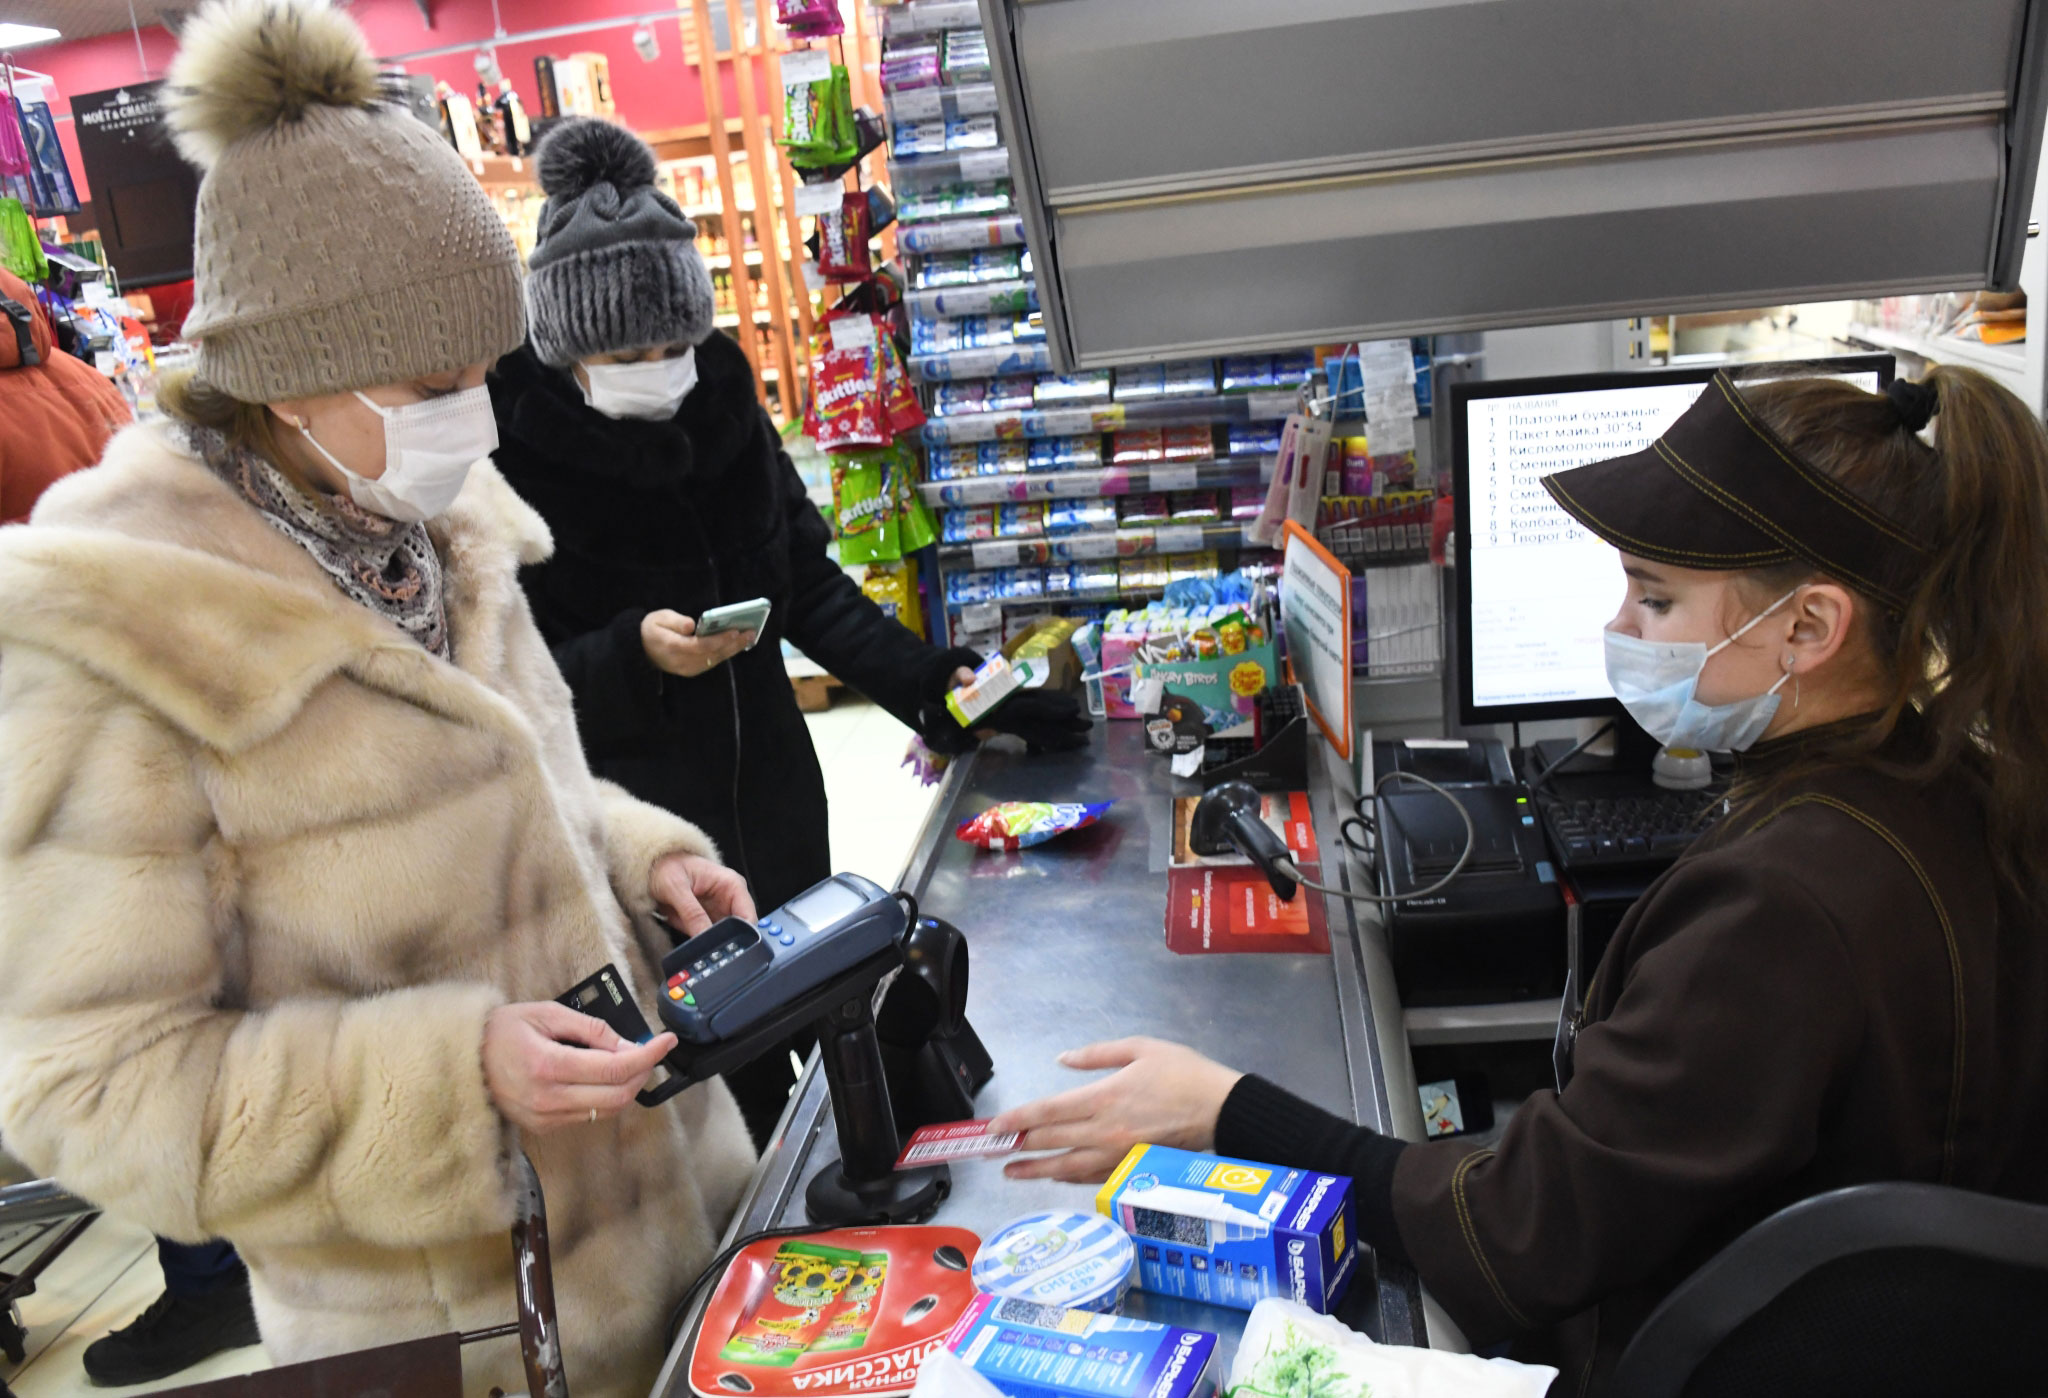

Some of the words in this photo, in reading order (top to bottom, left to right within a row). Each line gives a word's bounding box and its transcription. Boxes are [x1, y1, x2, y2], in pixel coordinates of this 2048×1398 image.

[1489, 417, 1495, 428] 1
[1508, 412, 1578, 427] Платочки
[1582, 406, 1660, 422] бумажные
[1488, 432, 1496, 443] 2
[1508, 428, 1549, 442] Пакет
[1488, 447, 1496, 458] 3
[1509, 438, 1632, 457] Кисломолочный
[1488, 461, 1496, 472] 4
[1509, 457, 1574, 471] Сменная
[1489, 476, 1497, 487] 5
[1489, 491, 1497, 502] 6
[1489, 505, 1497, 516] 7
[1489, 519, 1497, 531] 8
[1510, 517, 1570, 530] Колбаса
[1489, 534, 1497, 545] 9
[1510, 531, 1559, 545] Творог
[1184, 671, 1218, 687] BIRDS
[1039, 1261, 1103, 1294] СМЕТАНА
[1293, 1256, 1308, 1306] БАРЬЕ
[849, 1367, 919, 1389] ОРНАЯ
